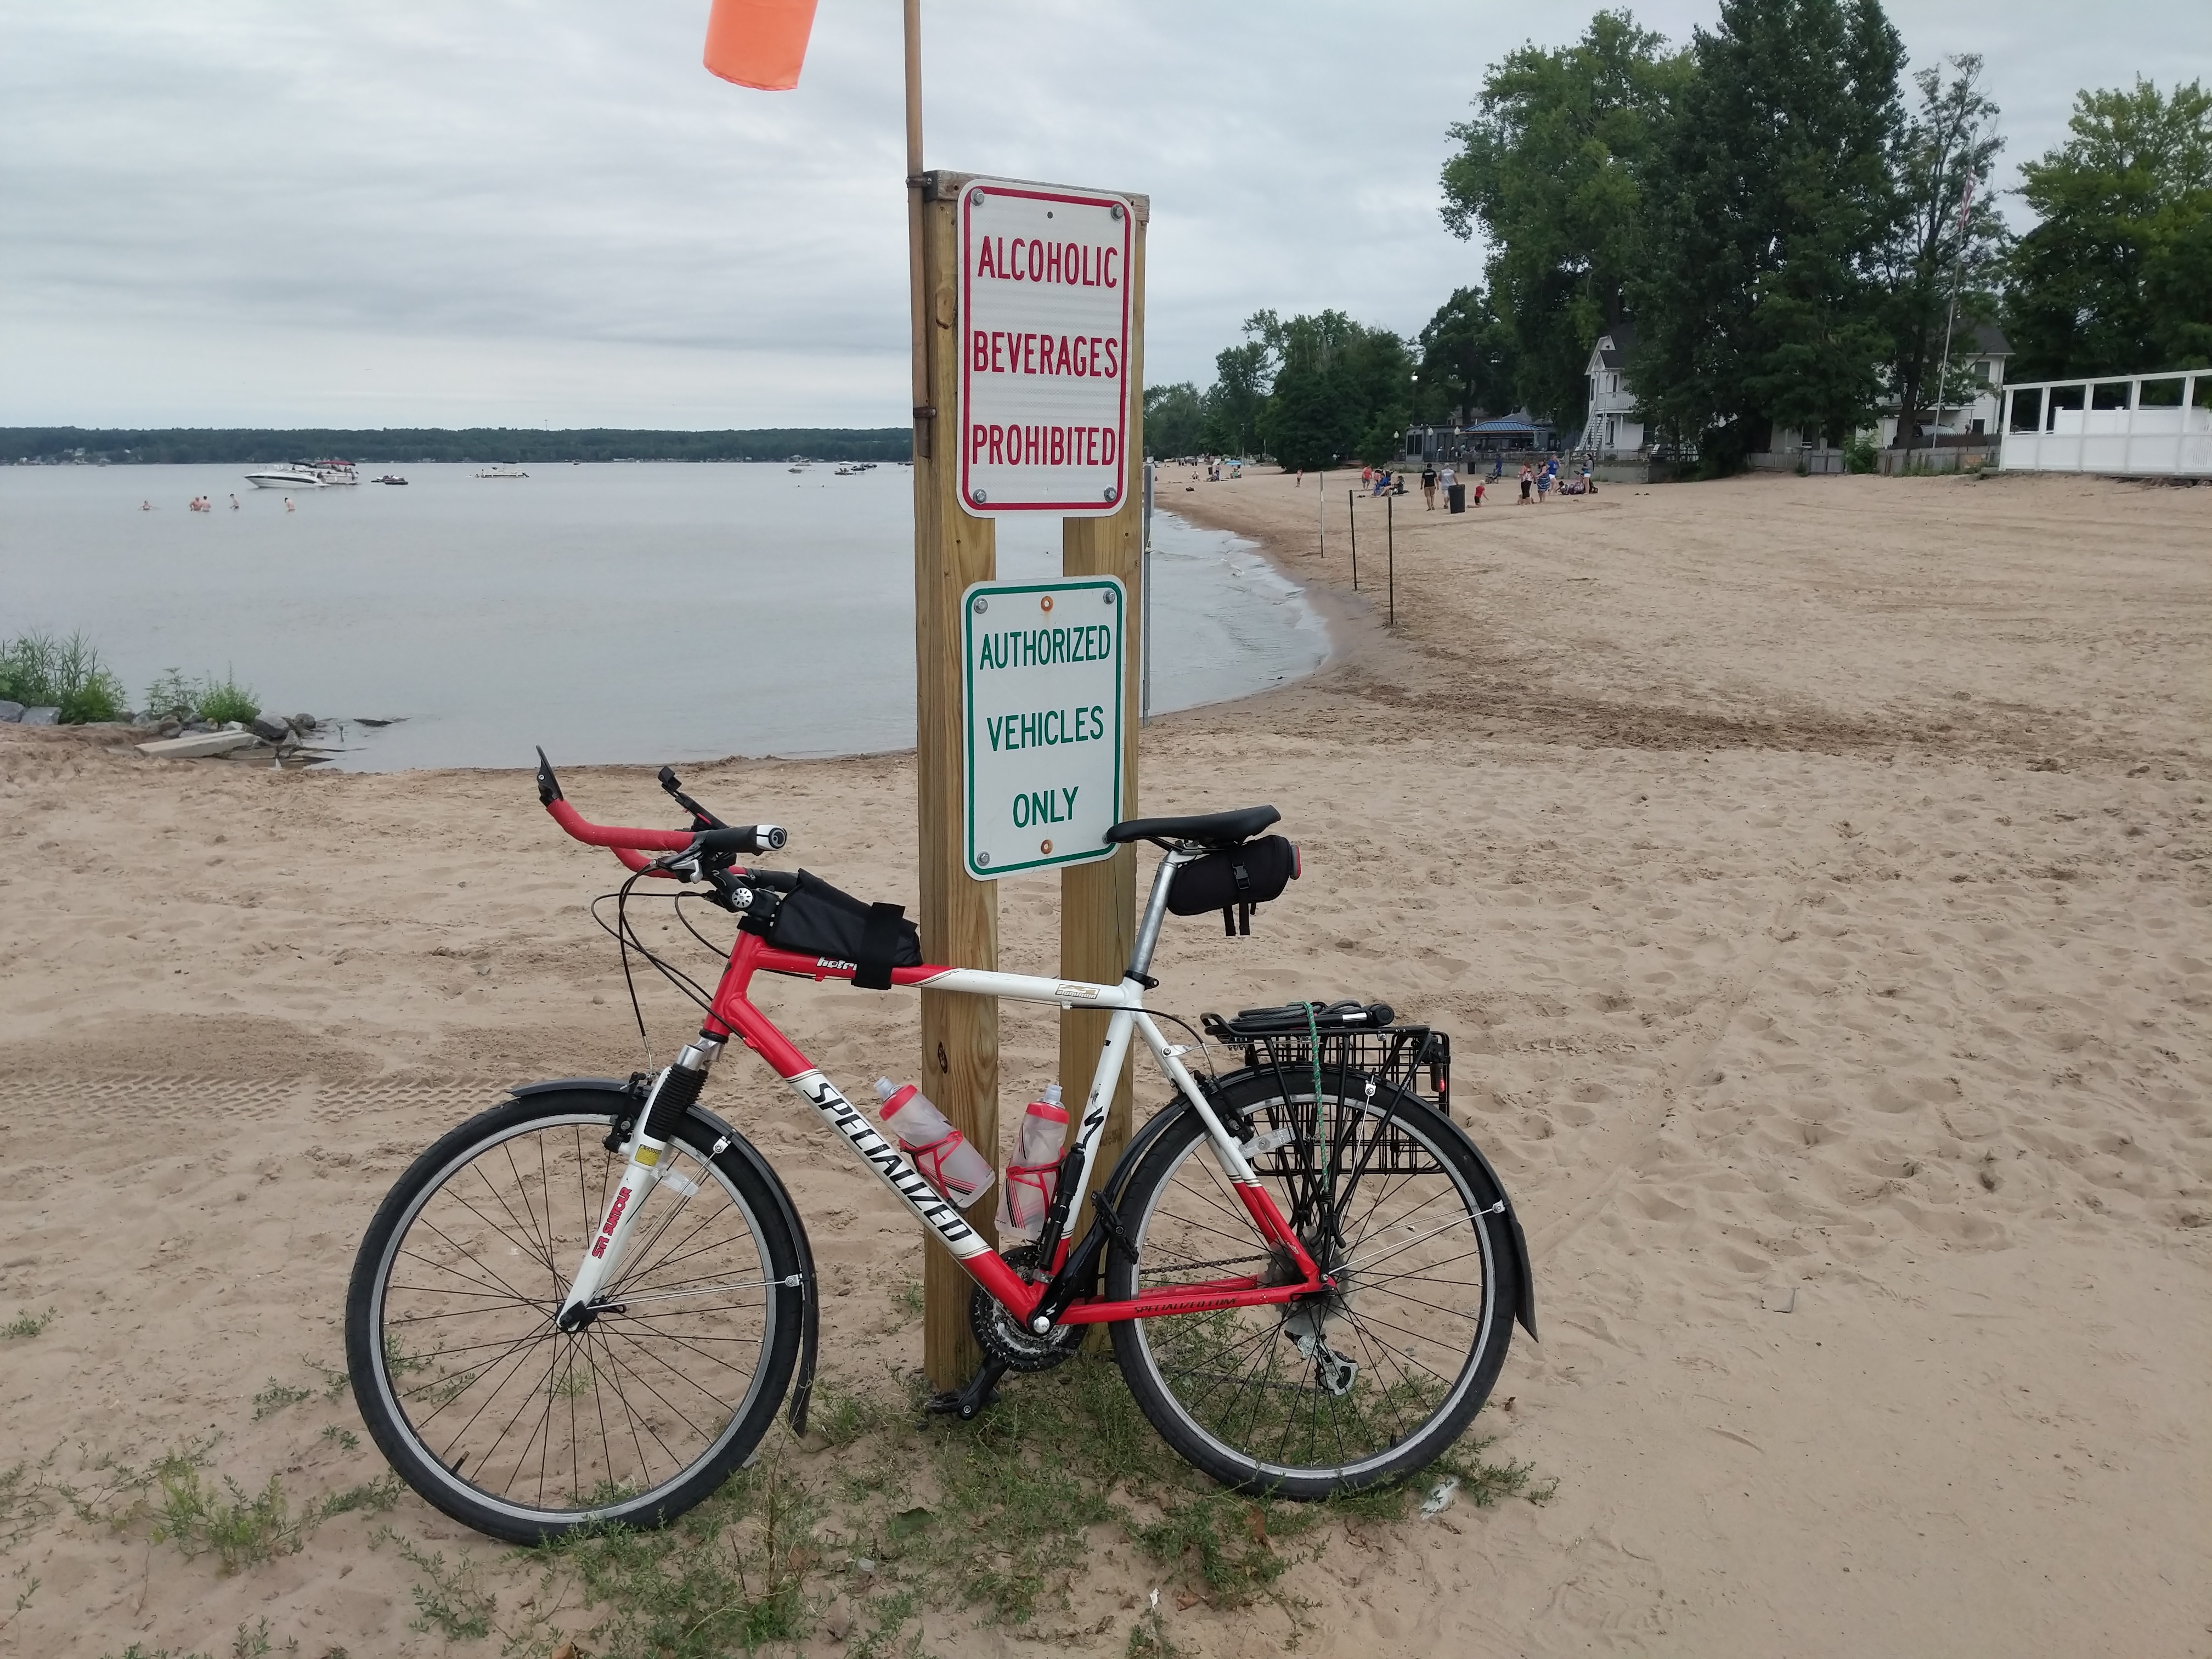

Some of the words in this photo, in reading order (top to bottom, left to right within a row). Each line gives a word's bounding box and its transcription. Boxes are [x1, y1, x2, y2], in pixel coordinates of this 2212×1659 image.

[978, 236, 1118, 288] ALCOHOLIC
[974, 331, 1118, 378] BEVERAGES
[973, 425, 1115, 466] PROHIBITED
[979, 625, 1111, 670] AUTHORIZED
[987, 706, 1104, 752] VEHICLES
[1013, 786, 1079, 828] ONLY
[803, 1082, 973, 1242] SPECIALIZED
[592, 1235, 610, 1259] SR
[602, 1187, 633, 1236] SUNTOUR
